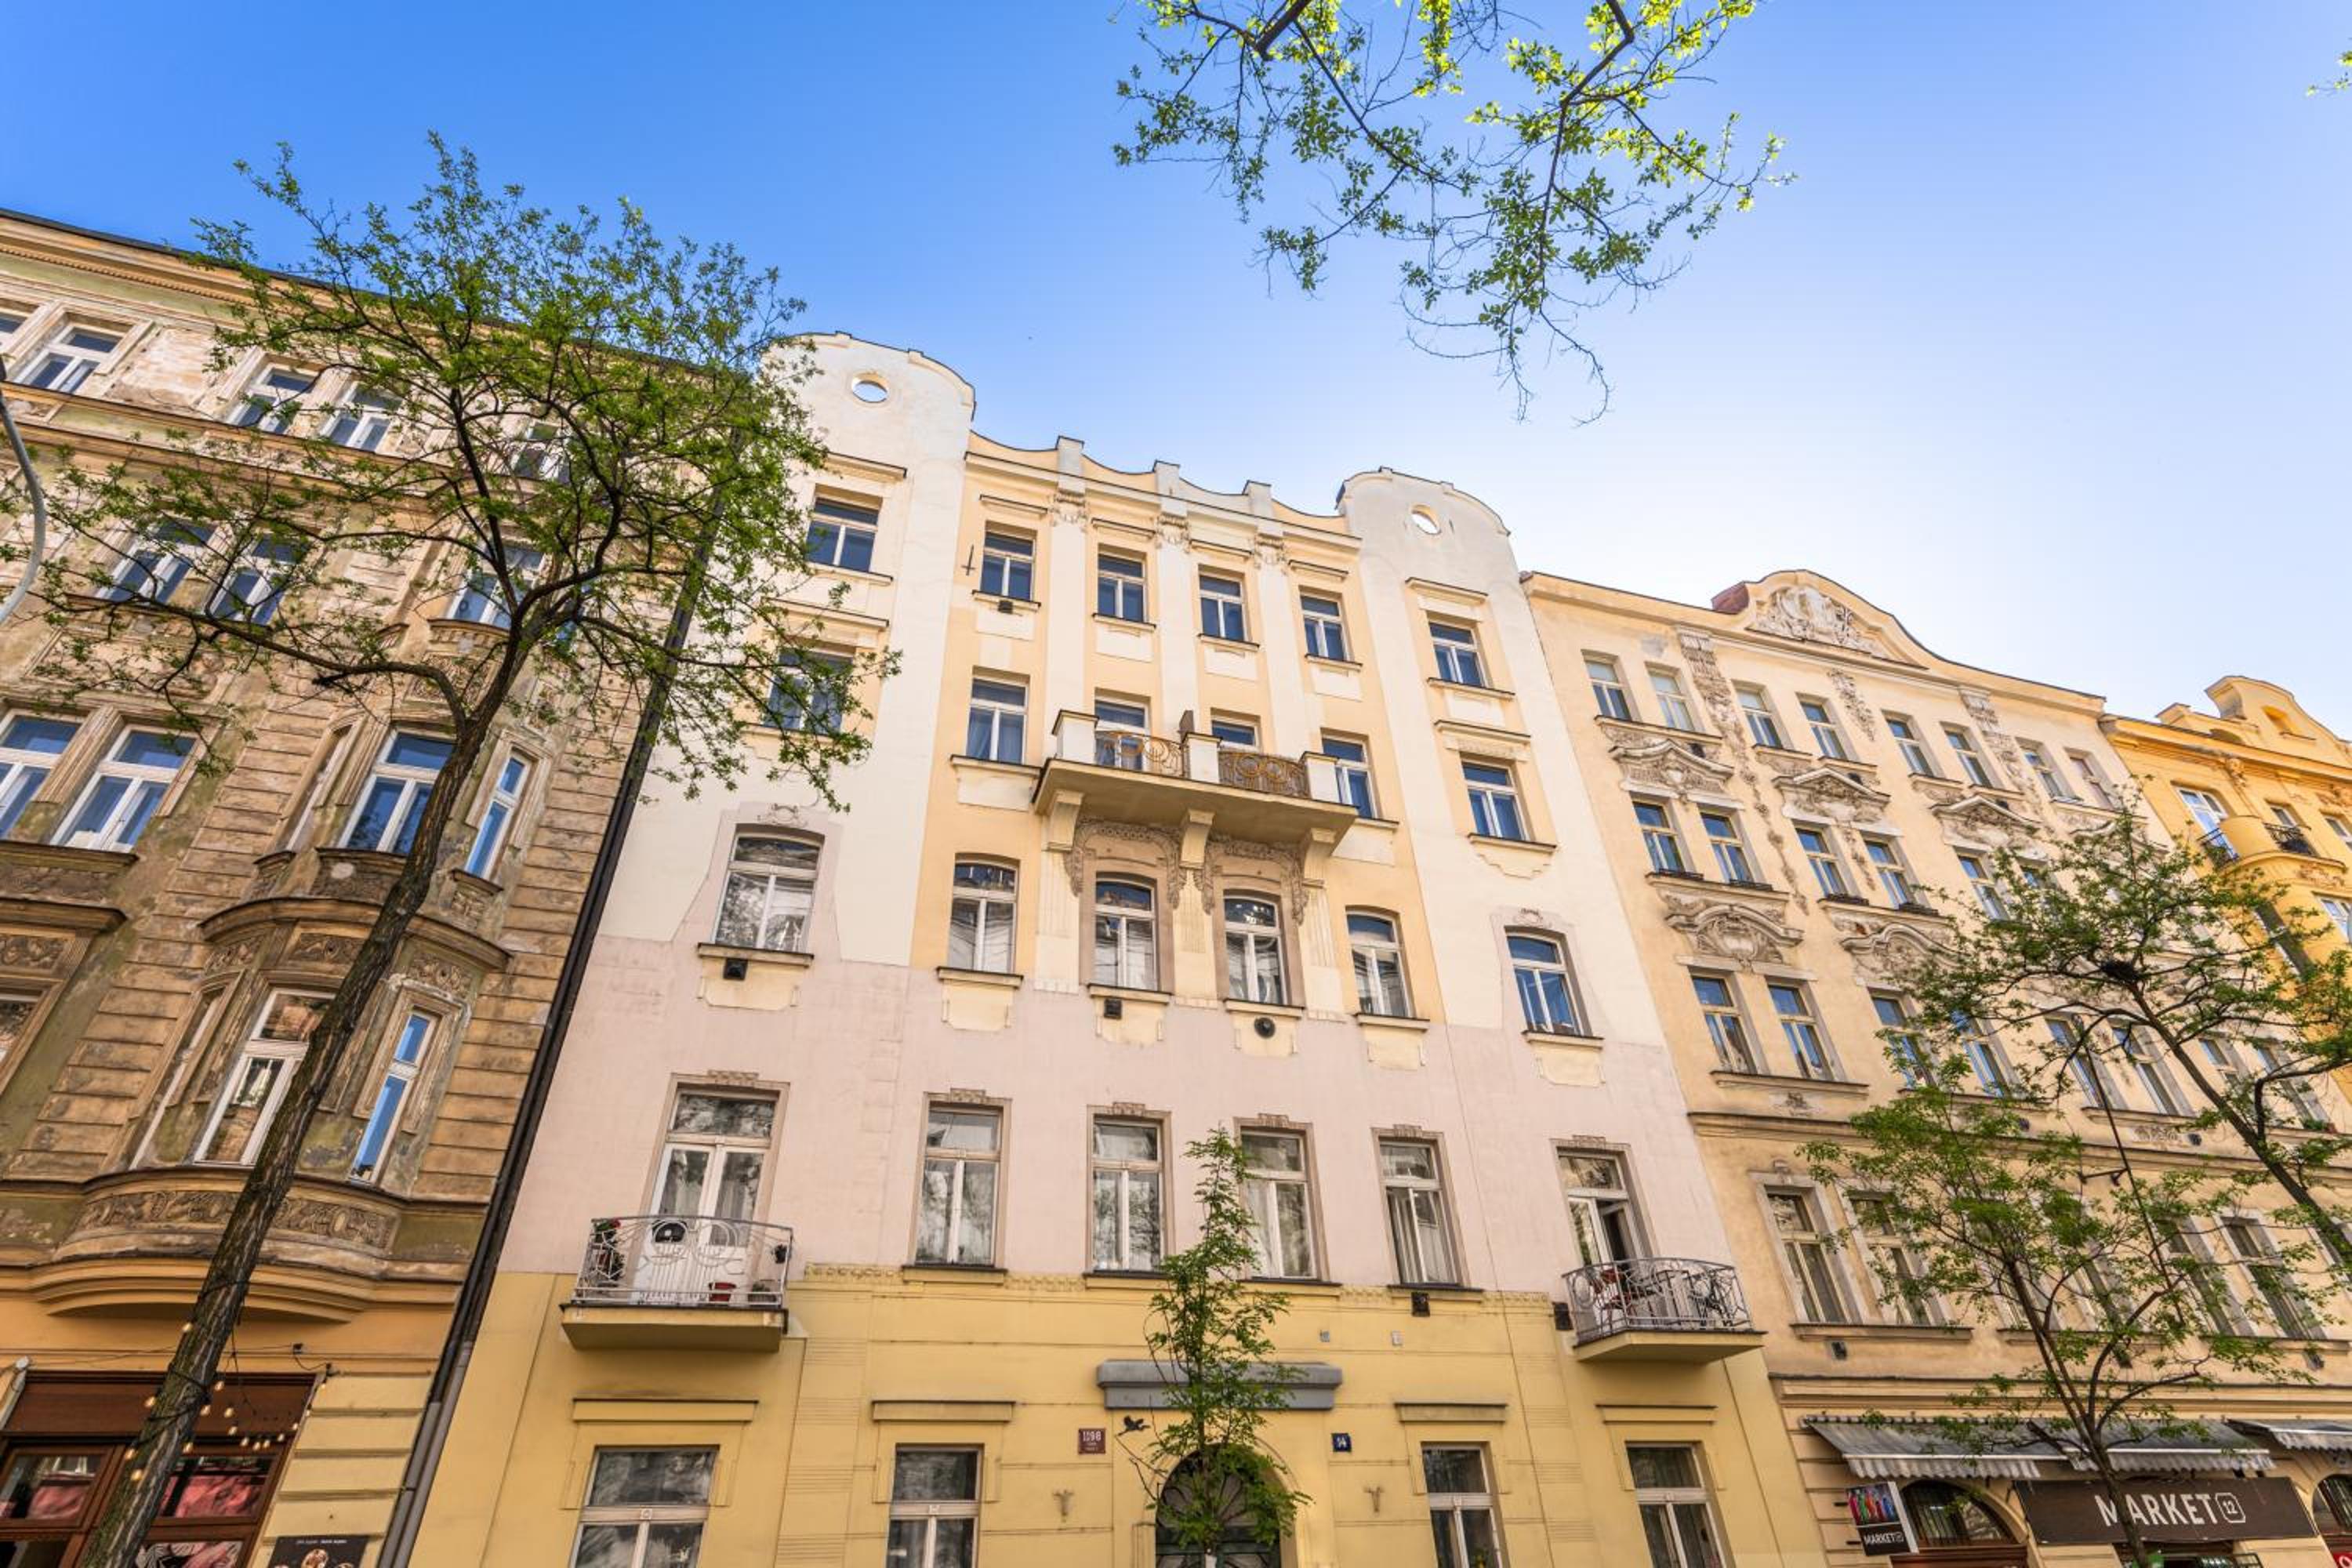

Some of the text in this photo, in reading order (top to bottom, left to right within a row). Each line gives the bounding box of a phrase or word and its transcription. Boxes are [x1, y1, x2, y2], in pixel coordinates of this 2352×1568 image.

[2094, 1493, 2238, 1526] MARKET 12
[1864, 1533, 1895, 1544] MARKET
